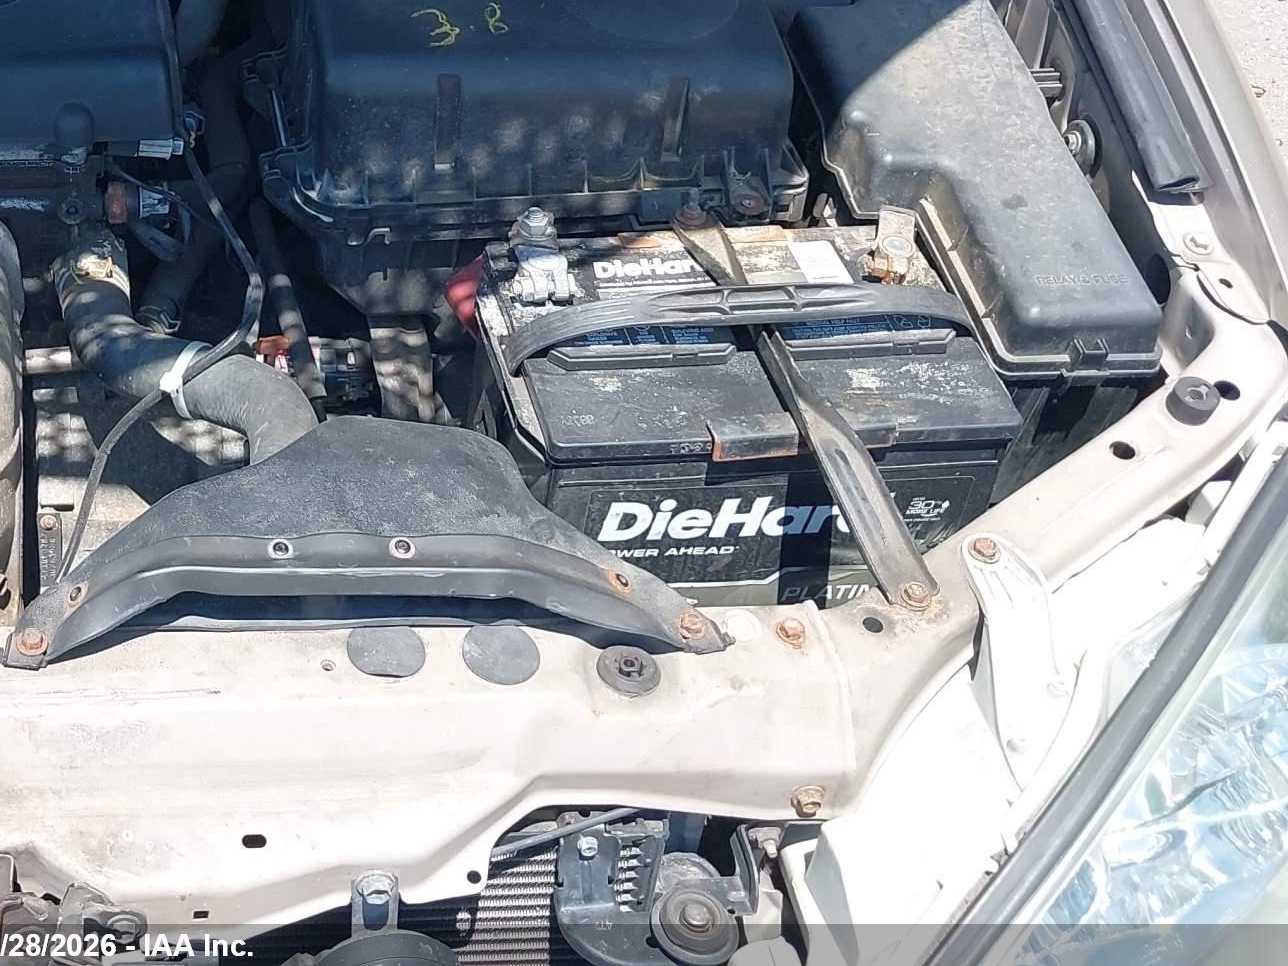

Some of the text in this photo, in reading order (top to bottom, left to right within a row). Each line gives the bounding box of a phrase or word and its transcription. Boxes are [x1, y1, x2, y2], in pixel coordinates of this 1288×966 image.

[593, 257, 704, 279] DieHar
[1035, 274, 1077, 285] RELAY
[1092, 274, 1128, 284] FUSE
[663, 545, 736, 556] AHEAD
